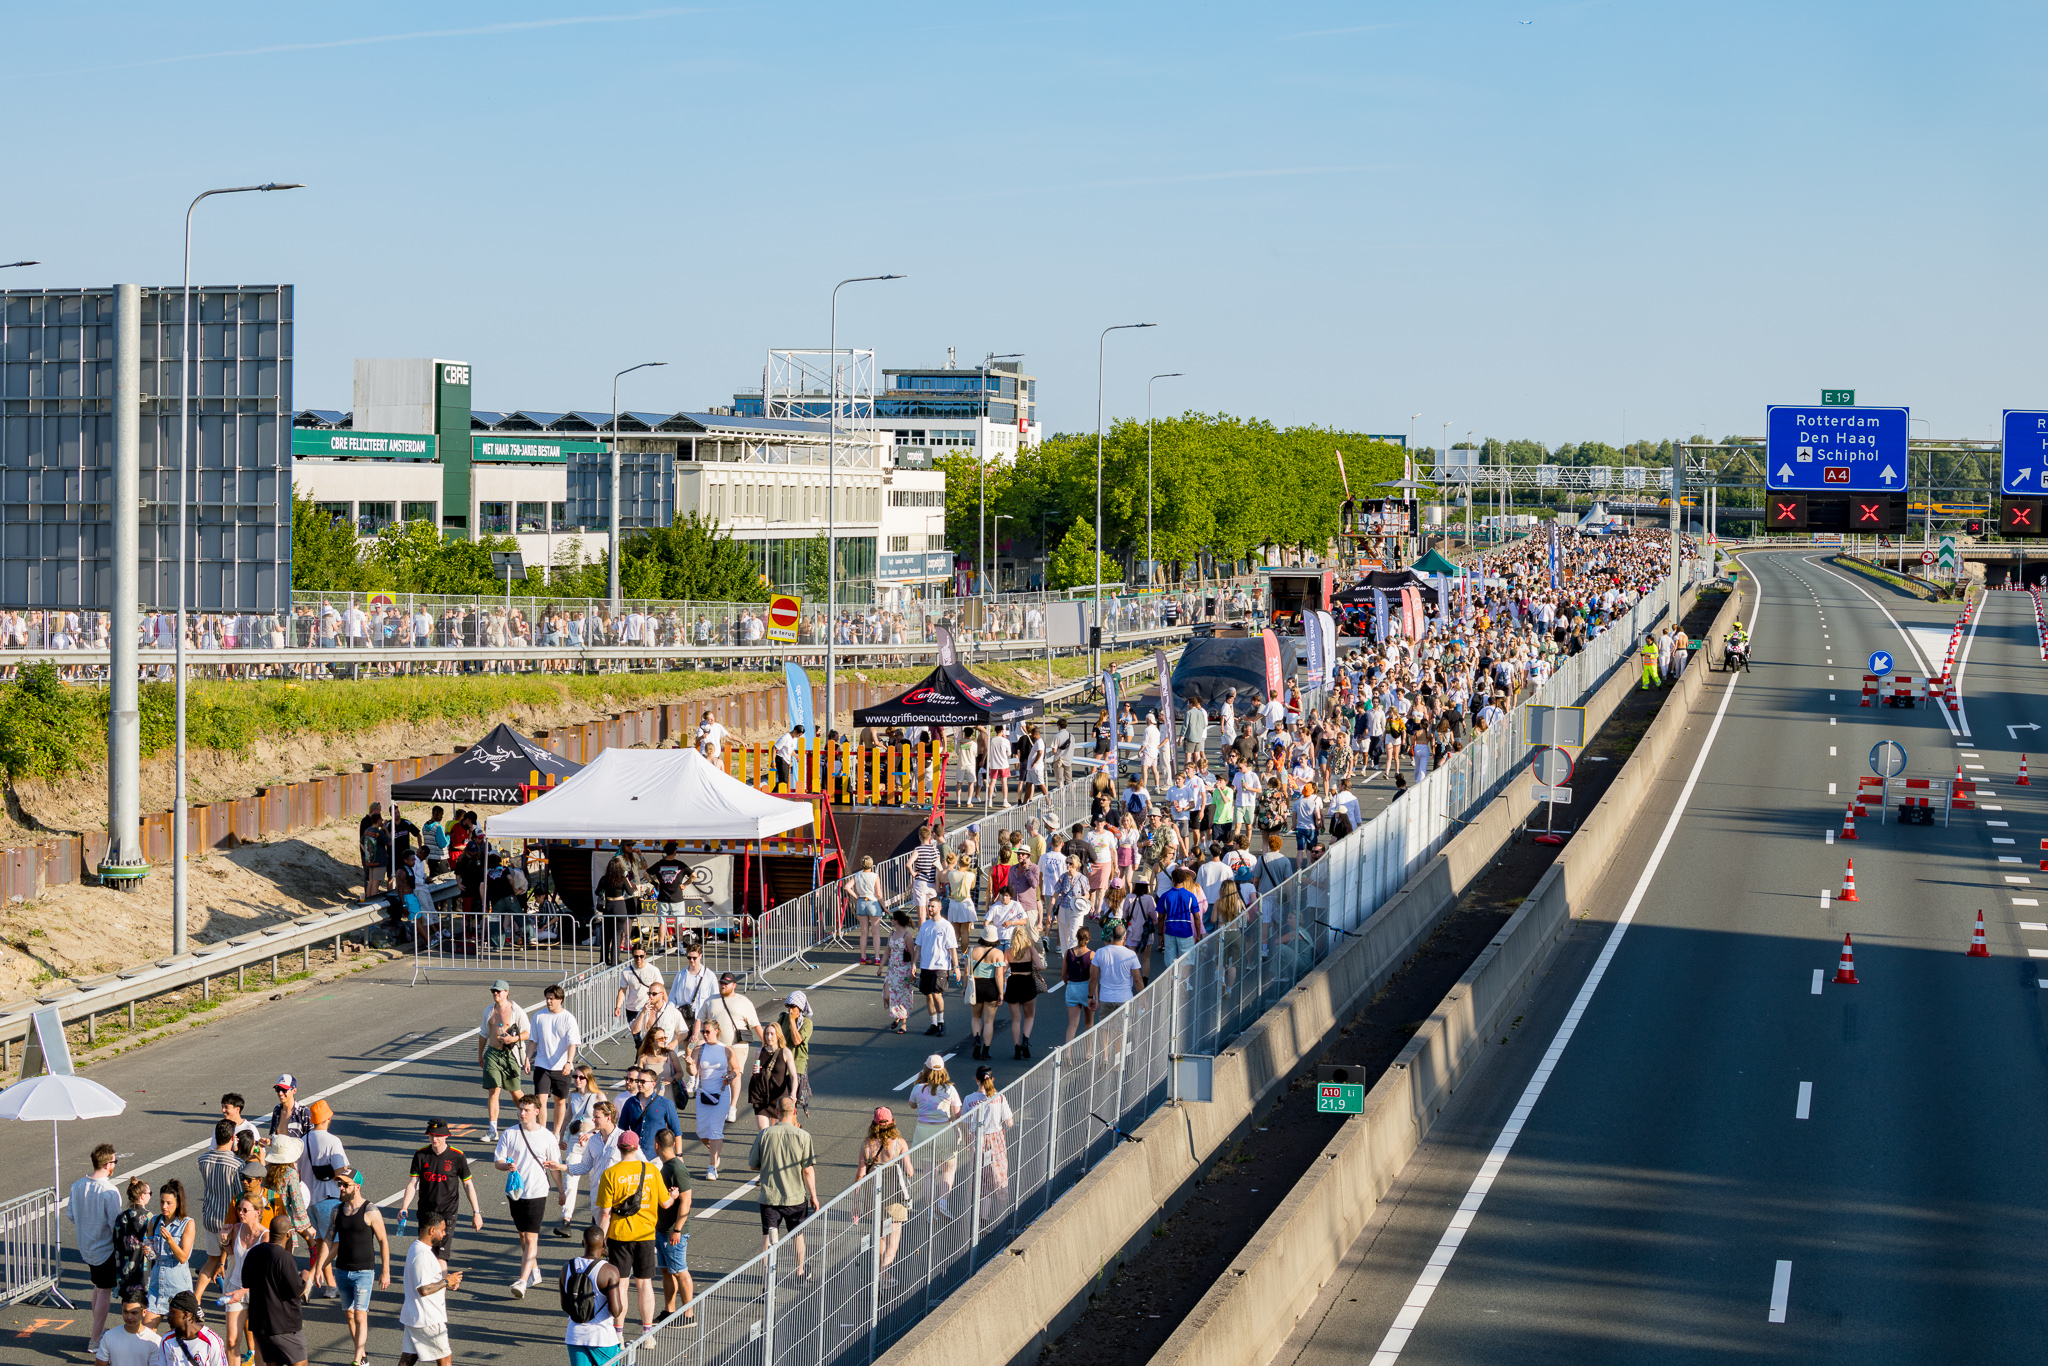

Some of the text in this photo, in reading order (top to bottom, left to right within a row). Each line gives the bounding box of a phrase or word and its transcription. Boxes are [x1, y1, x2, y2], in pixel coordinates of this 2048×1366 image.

[444, 365, 469, 385] CBRE
[1825, 393, 1850, 402] E 19
[1796, 414, 1880, 427] Rotterdam
[330, 436, 426, 453] CBRE FELICITEERT AMSTERDAM
[1800, 432, 1876, 447] Den Haag
[482, 442, 494, 455] MET
[494, 442, 509, 456] HAAR
[537, 444, 561, 458] BESTAAN
[1817, 449, 1879, 463] Schiphol
[865, 713, 978, 725] www.griffioenoutdoor.nl
[1323, 1088, 1355, 1097] A10 Li
[1321, 1098, 1346, 1110] 21,9
[618, 1173, 654, 1184] Golf Riers
